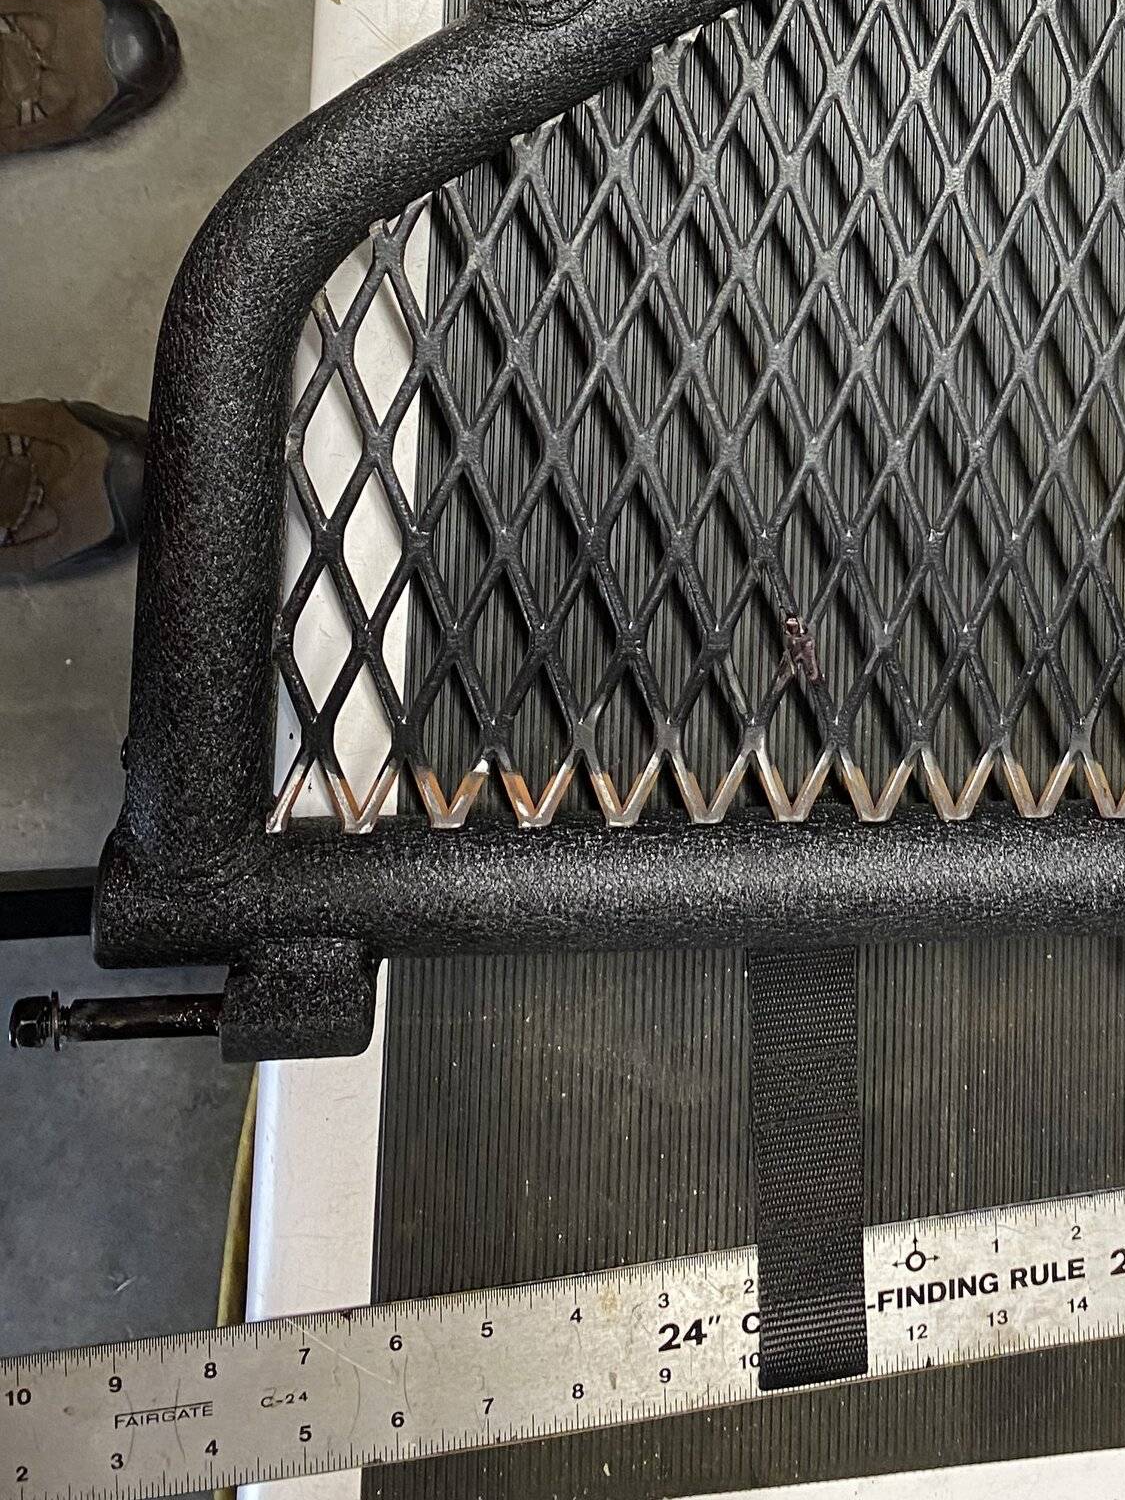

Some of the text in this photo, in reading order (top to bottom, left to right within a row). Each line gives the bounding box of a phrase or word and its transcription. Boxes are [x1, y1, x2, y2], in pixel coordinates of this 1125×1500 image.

[1011, 1258, 1085, 1289] RULE
[5, 1388, 31, 1406] 10
[109, 1376, 122, 1392] 9
[204, 1362, 217, 1379] 8
[299, 1348, 310, 1365] 7
[389, 1335, 402, 1351] 6
[481, 1321, 493, 1338] 5
[570, 1308, 582, 1323] 4
[658, 1293, 669, 1308] 3
[744, 1279, 754, 1294] 2
[1072, 1226, 1081, 1240] 2
[16, 1466, 28, 1482] 2
[111, 1453, 123, 1469] 3
[205, 1440, 218, 1456] 4
[299, 1425, 311, 1442] 5
[391, 1412, 404, 1428] 6
[483, 1398, 494, 1414] 7
[572, 1383, 584, 1399] 8
[659, 1368, 671, 1383] 9
[739, 1351, 761, 1368] 10
[907, 1324, 927, 1341] 12
[987, 1310, 1008, 1327] 13
[1068, 1297, 1088, 1313] 14
[261, 1392, 308, 1408] C-24
[115, 1401, 212, 1429] FAIRGATE
